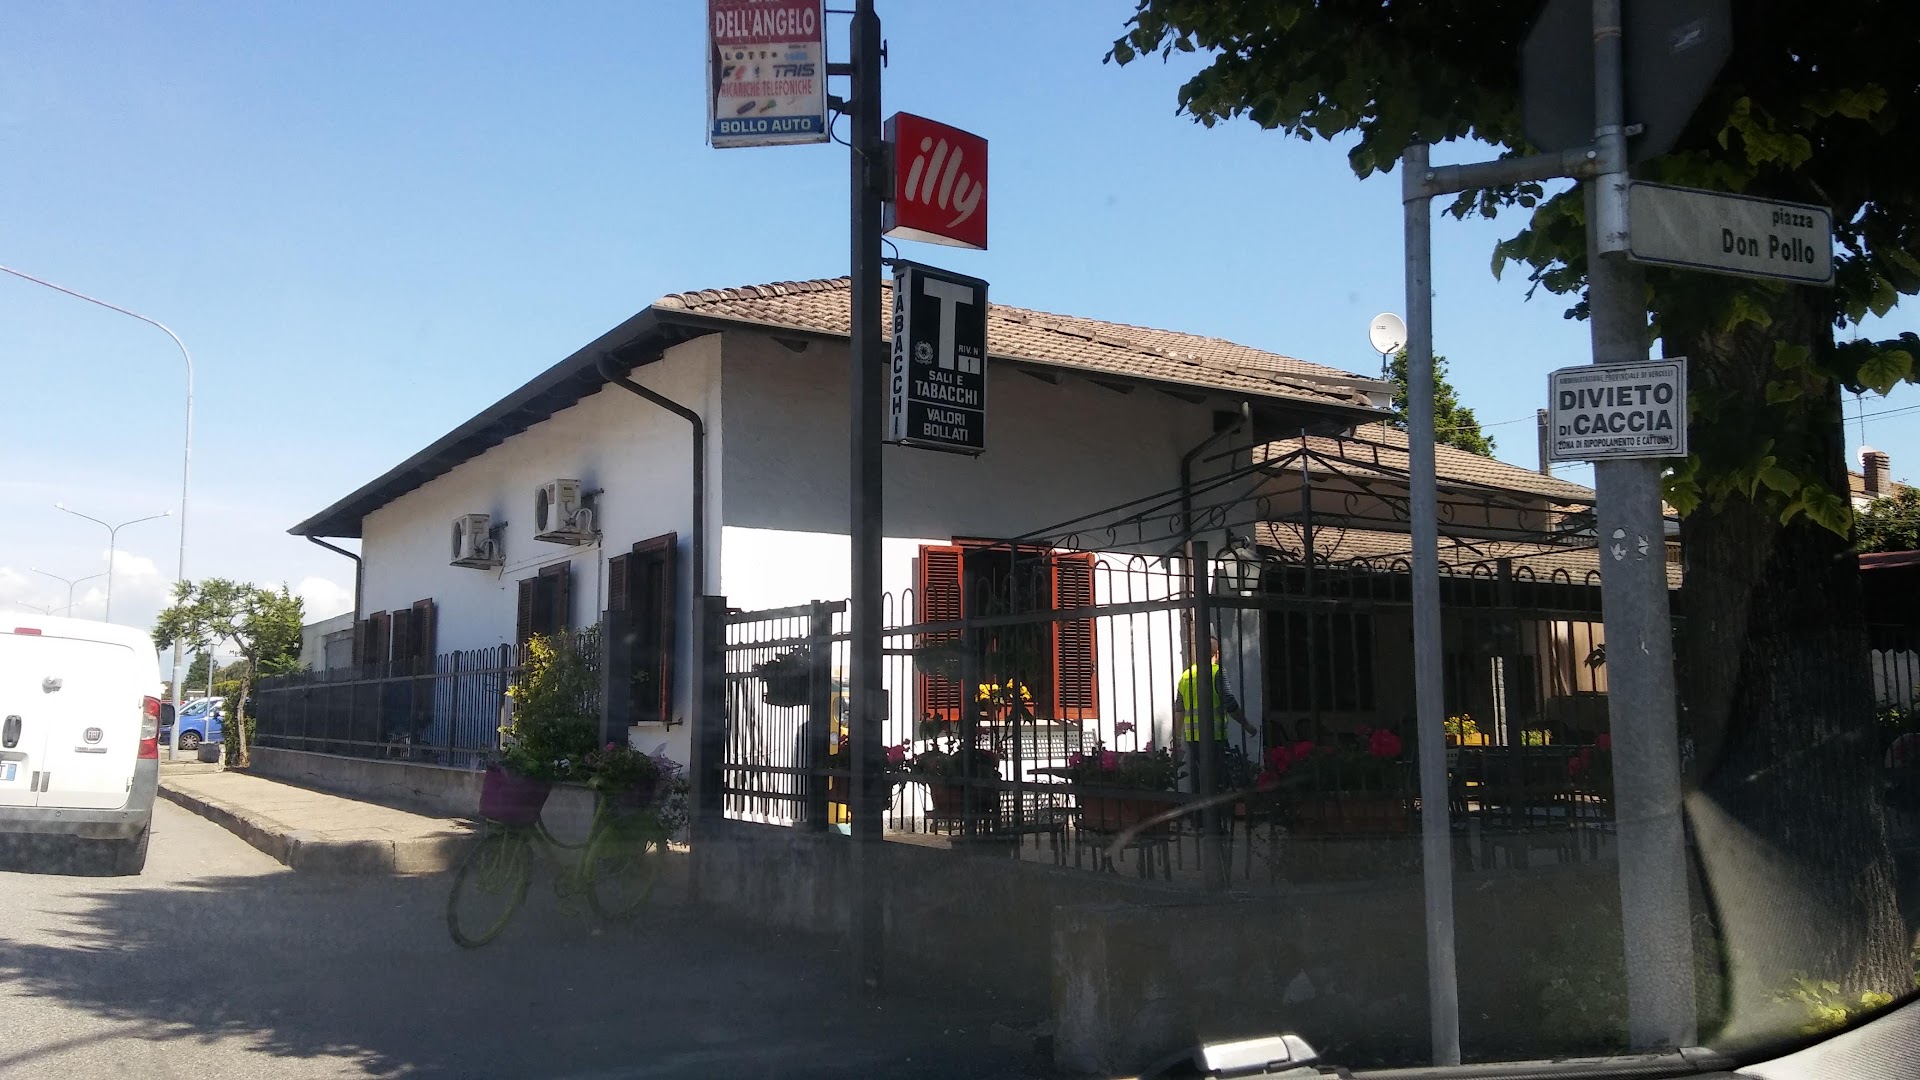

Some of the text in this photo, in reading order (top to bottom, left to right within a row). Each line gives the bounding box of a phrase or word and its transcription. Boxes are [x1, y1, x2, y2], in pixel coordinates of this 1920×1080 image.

[715, 7, 815, 38] DELL'ANGELO
[773, 63, 815, 78] TRIS
[762, 79, 812, 97] TELEFONICHE
[720, 118, 811, 134] BOLLO AUTO
[904, 136, 982, 228] illy
[1772, 208, 1813, 229] piazza
[1722, 228, 1815, 264] Don Pollo
[923, 276, 974, 371] T
[891, 273, 905, 435] TABACCHI
[958, 344, 972, 355] RIV.
[928, 370, 963, 386] SALI E
[915, 380, 978, 405] TABACCHI
[1560, 383, 1673, 411] DIVIETO
[927, 407, 966, 426] VALORI
[1559, 409, 1673, 436] DI CACCIA
[923, 422, 968, 442] BOLLATI
[1576, 440, 1582, 449] DI
[1584, 437, 1635, 448] RIPOPOLAMENTO
[1637, 436, 1641, 446] E
